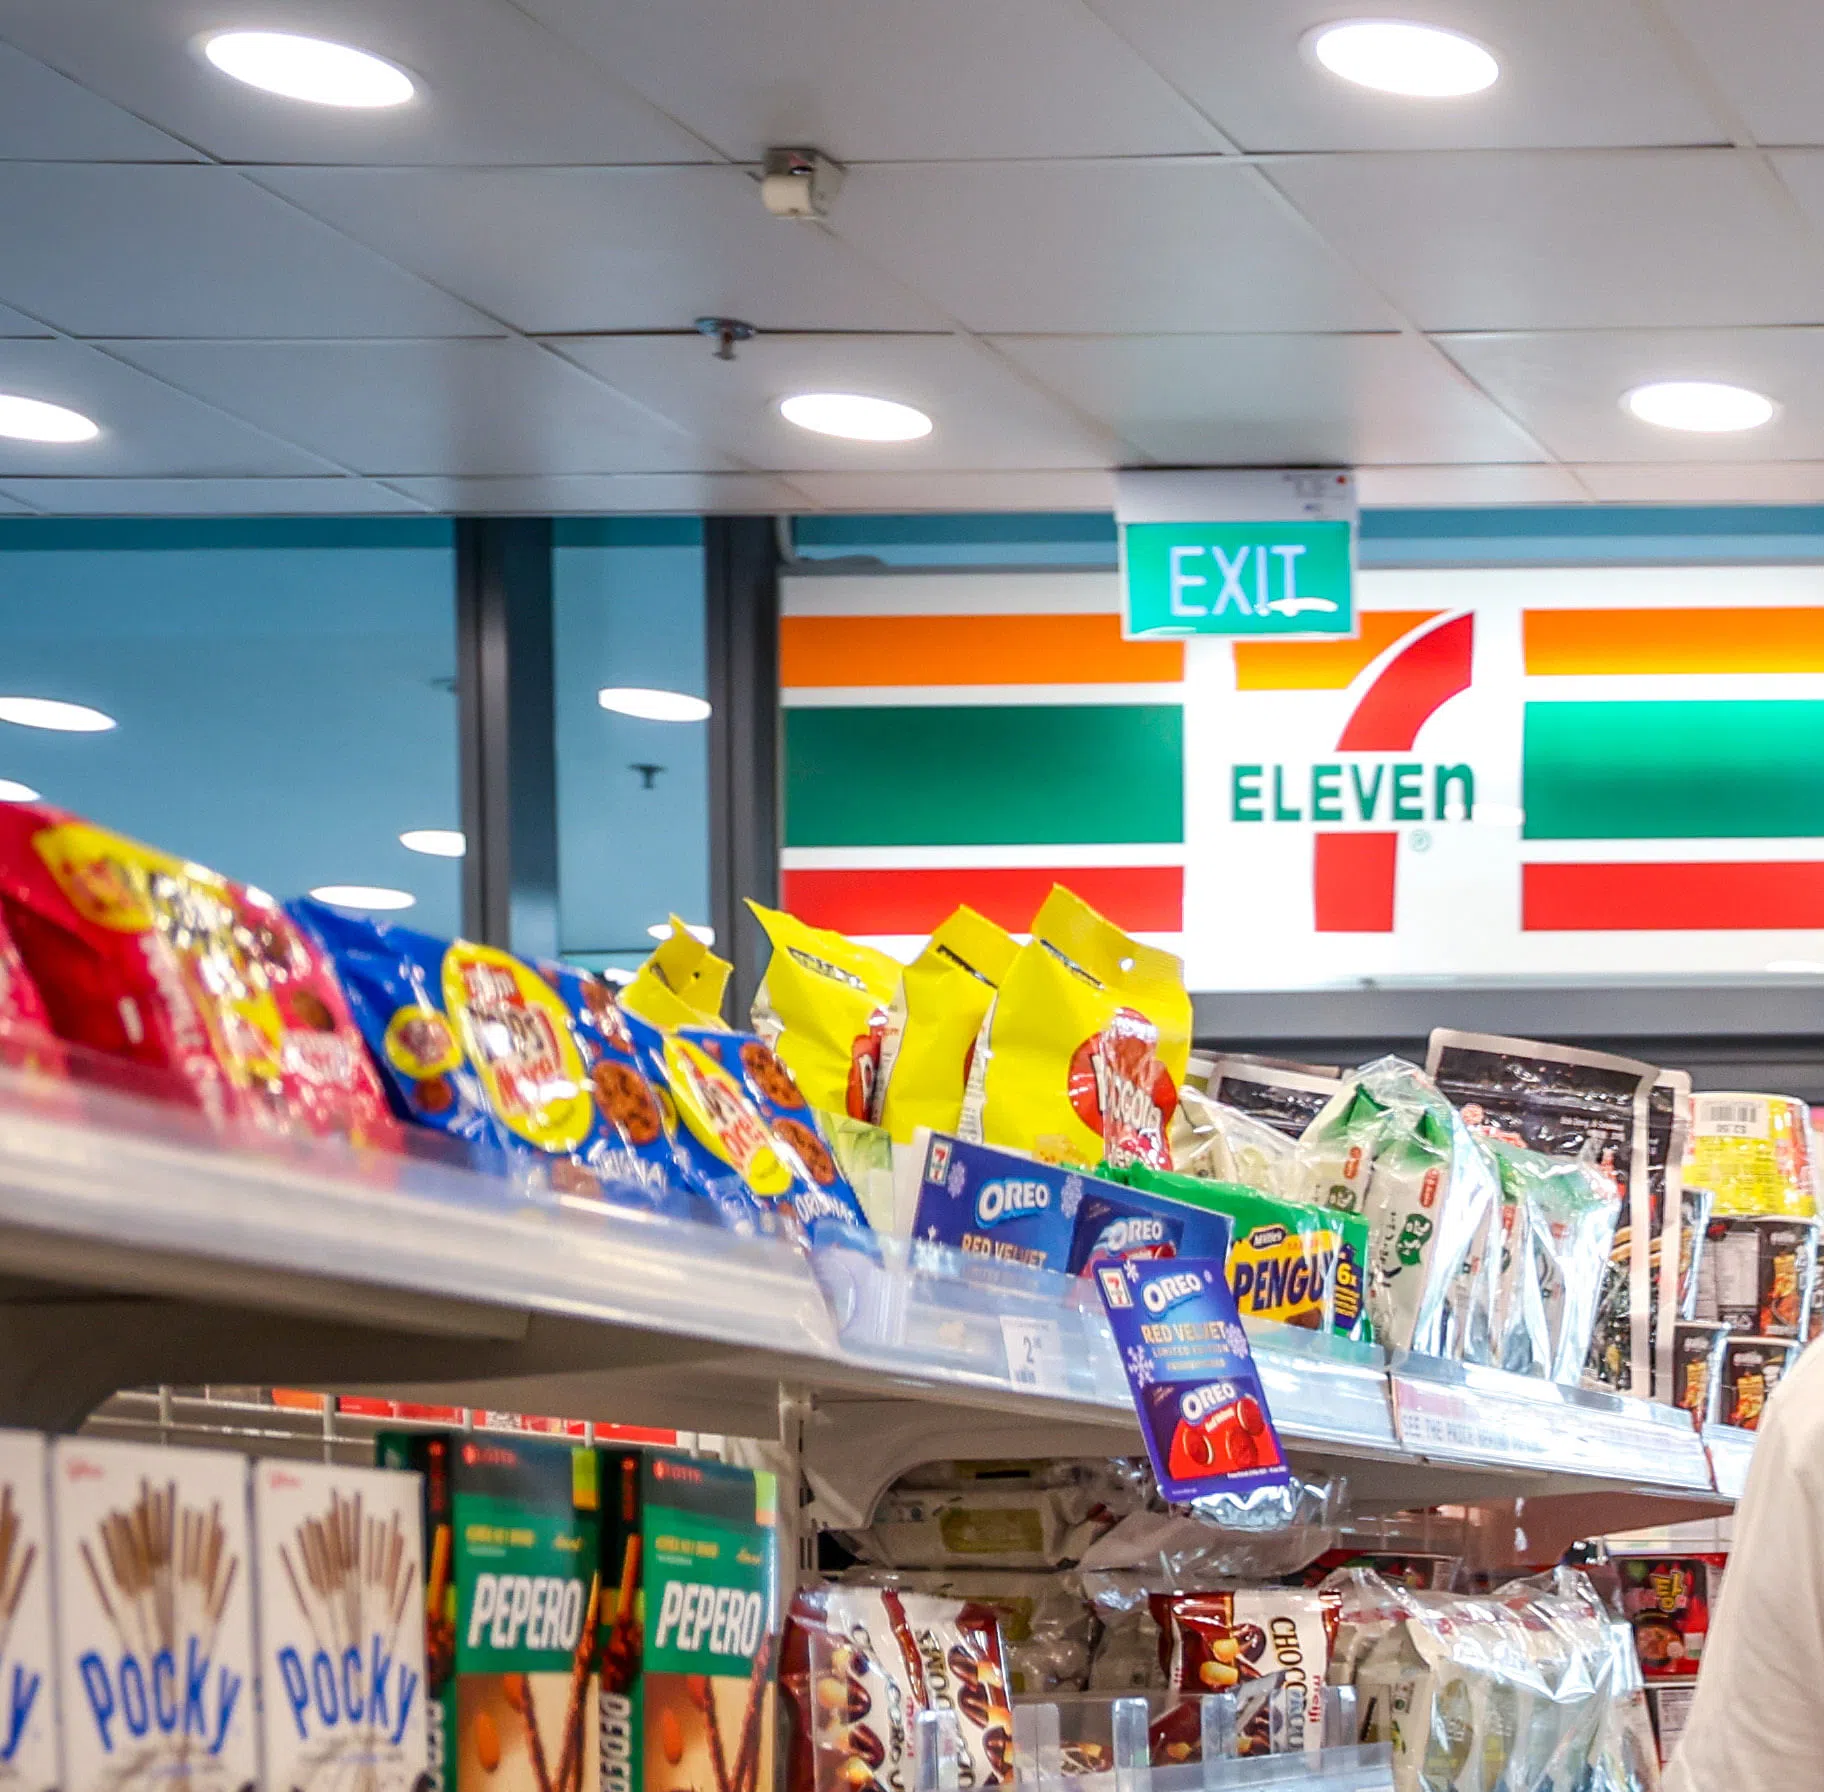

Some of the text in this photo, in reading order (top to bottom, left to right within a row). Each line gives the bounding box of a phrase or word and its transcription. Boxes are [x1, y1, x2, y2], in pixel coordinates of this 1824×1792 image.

[1167, 543, 1308, 617] EXIT
[1314, 610, 1475, 932] 7
[979, 1182, 1049, 1221] OREO
[961, 1233, 991, 1256] RED
[1108, 1219, 1163, 1251] OREO
[1143, 1273, 1202, 1313] OREO
[1234, 1250, 1336, 1312] PENGU
[1141, 1325, 1172, 1344] RED
[1182, 1384, 1236, 1421] OREO
[467, 1573, 584, 1651] PEPERO
[654, 1580, 763, 1658] PEPERO
[1308, 1674, 1322, 1723] meiji
